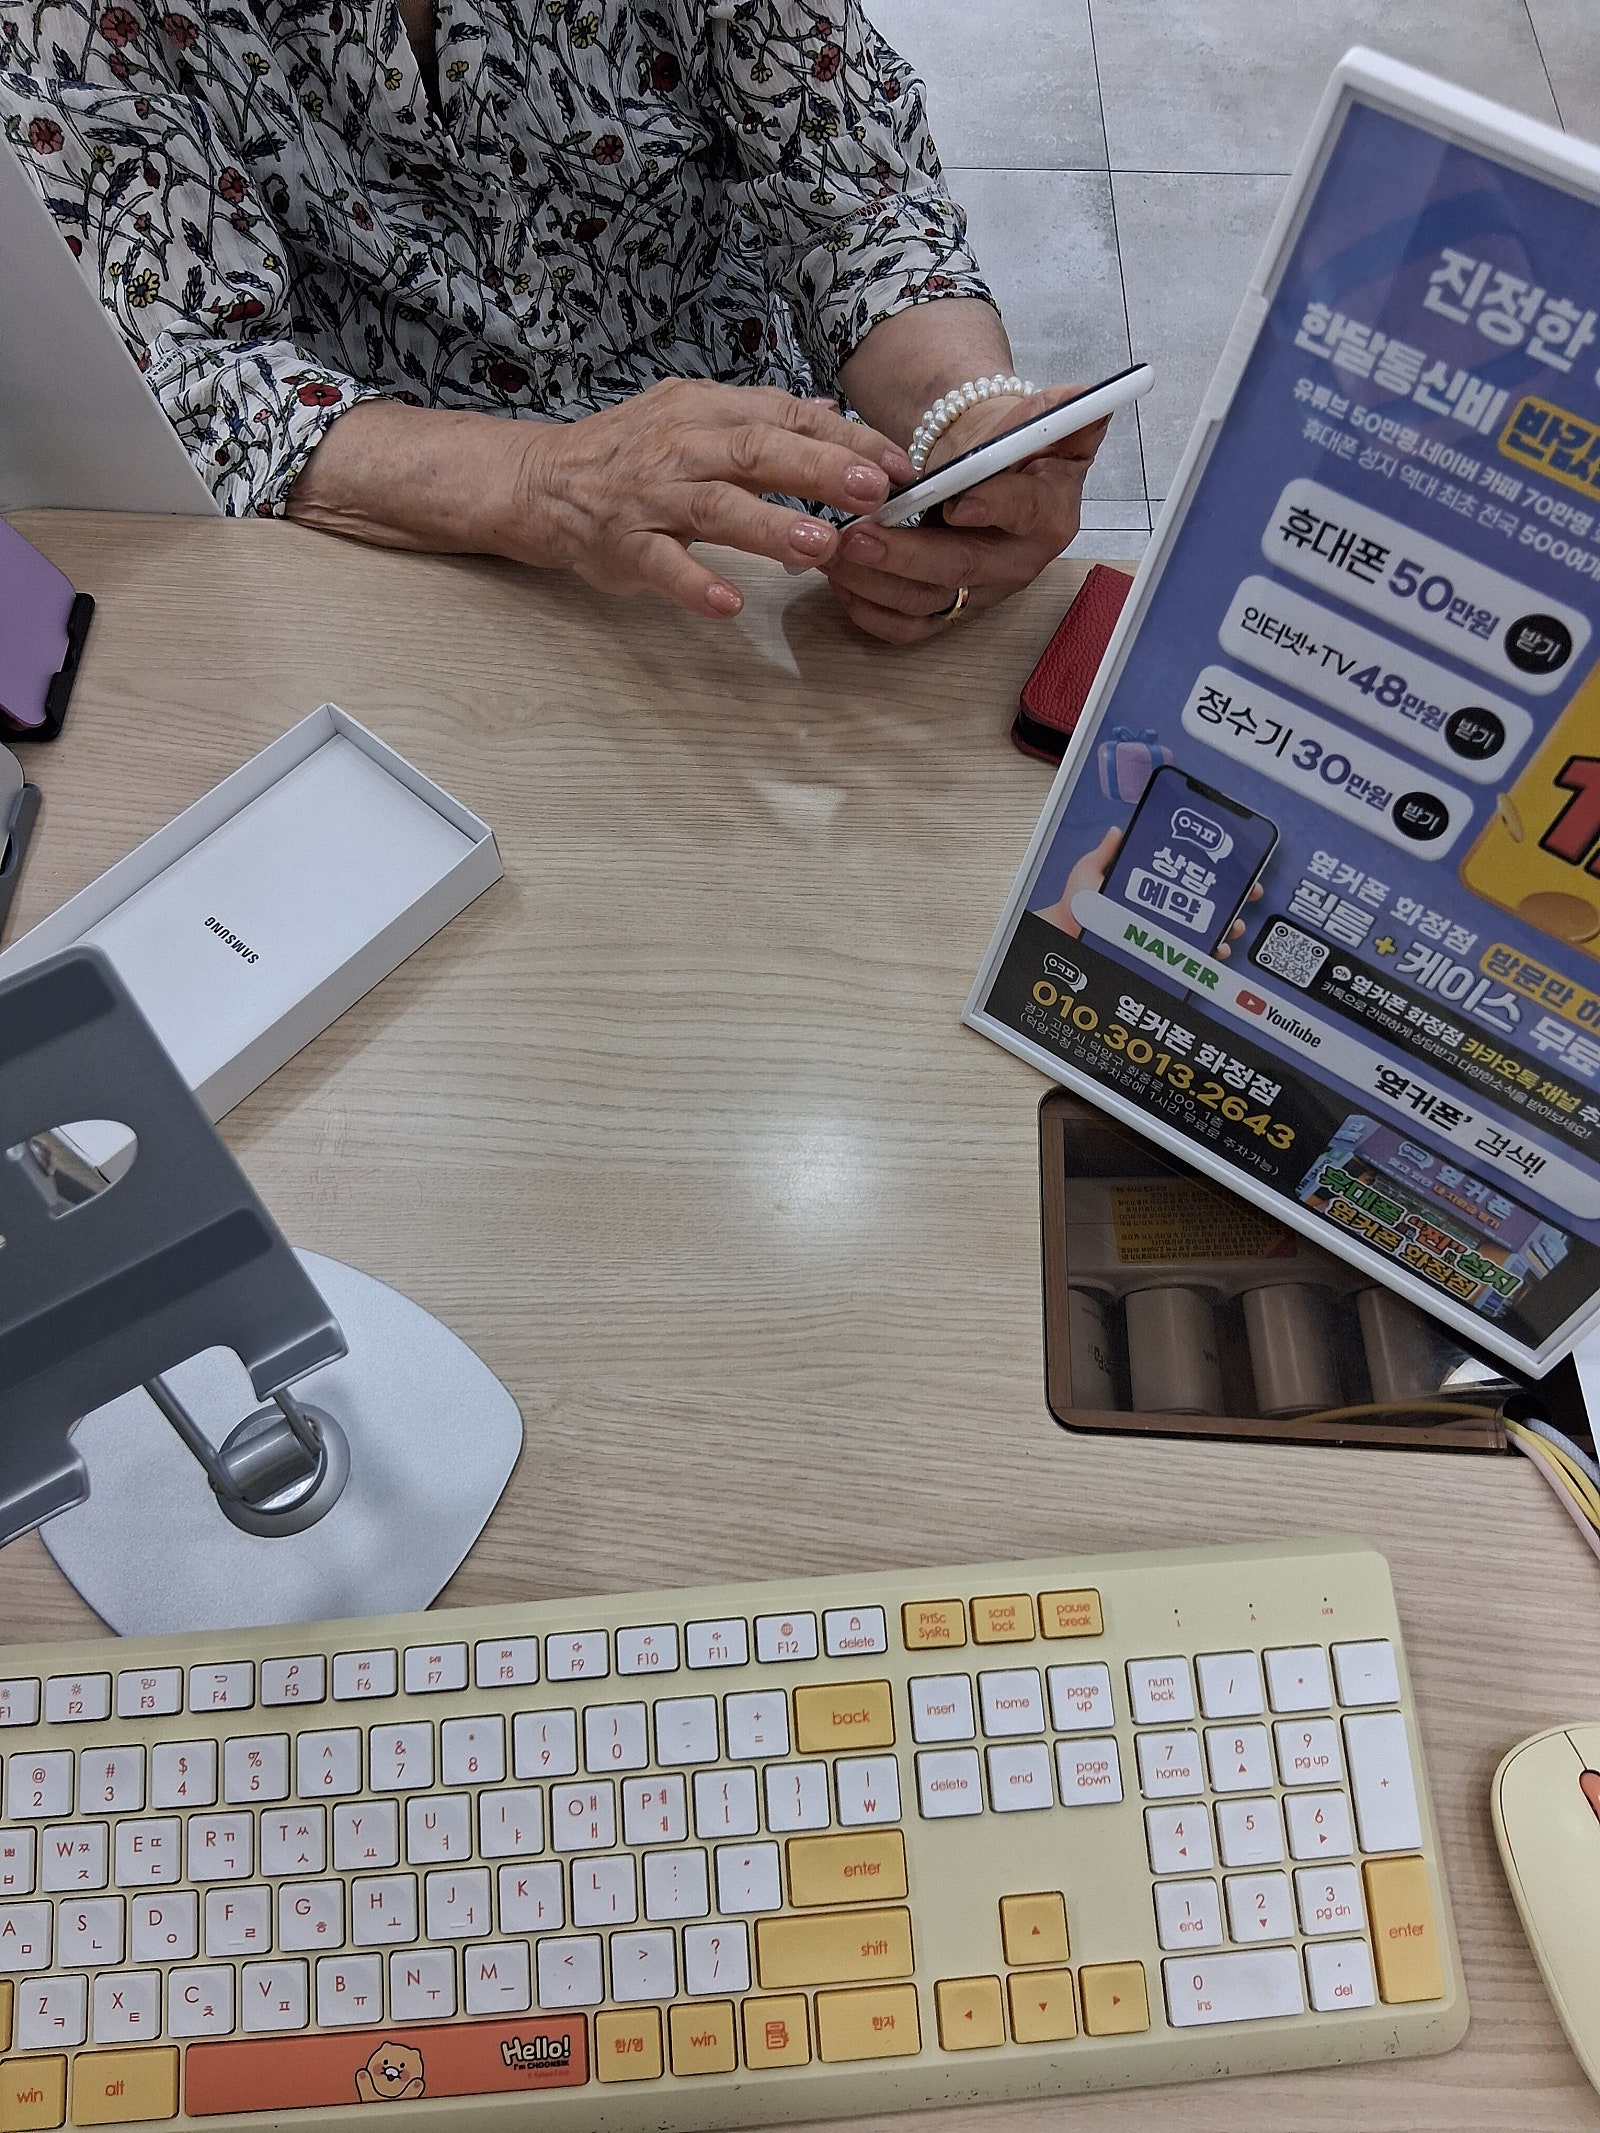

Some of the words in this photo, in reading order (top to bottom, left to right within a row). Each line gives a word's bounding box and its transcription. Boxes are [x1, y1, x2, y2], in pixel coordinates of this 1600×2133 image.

[1422, 247, 1597, 373] 진정한
[1294, 302, 1510, 435] 한달통신비
[1293, 377, 1350, 420] 유튜브
[1478, 466, 1523, 502] 카페
[1522, 487, 1594, 538] 70만명
[1302, 417, 1359, 461] 휴대폰
[1358, 447, 1399, 479] 성지
[1400, 463, 1439, 498] 역대
[1439, 482, 1479, 518] 최초
[1478, 503, 1520, 538] 전국
[1279, 505, 1391, 585] 휴대폰
[1388, 558, 1500, 641] 50만원
[1517, 626, 1563, 663] 받기
[1455, 718, 1497, 750] 받기
[1196, 685, 1294, 758] 정수기
[1291, 739, 1395, 812] 30만원
[1401, 801, 1441, 832] 받기
[1153, 846, 1217, 897] 상담
[1137, 876, 1203, 924] 예약
[1307, 850, 1390, 908] 옆커폰
[1390, 896, 1479, 956] 화정점
[1488, 950, 1576, 1009] 방문만
[204, 915, 259, 965] SAMSUNG
[1123, 923, 1220, 991] NAVER
[1287, 878, 1375, 949] 필름
[1374, 936, 1397, 956] +
[1396, 941, 1522, 1034] 케이스
[1025, 1001, 1047, 1022] 경기
[1049, 1014, 1086, 1046] 고양시
[1089, 1037, 1125, 1067] 덕양구
[1265, 1006, 1322, 1049] YouTube
[1115, 994, 1195, 1056] 옆커폰
[1194, 1042, 1282, 1107] 화정점
[1350, 973, 1406, 1015] 옆커폰
[1403, 1004, 1465, 1051] 화정점
[1461, 1036, 1540, 1090] 카카오톡
[1540, 1081, 1581, 1114] 채널
[1032, 980, 1296, 1150] 010.3013.2643
[1150, 1091, 1181, 1115] 1시간
[1182, 1112, 1222, 1140] 무료로
[1223, 1137, 1280, 1176] 주차가능)
[1474, 1127, 1548, 1179] 검색!
[1320, 1167, 1402, 1226] 휴대폰
[1457, 1253, 1522, 1297] 성지
[1329, 1200, 1402, 1252] 옆커폰
[1401, 1245, 1478, 1299] 화정점
[988, 1607, 1016, 1620] scroll
[1055, 1601, 1091, 1614] pause
[918, 1611, 948, 1628] PrtSc
[990, 1616, 1016, 1632] lock
[1057, 1611, 1092, 1627] break
[919, 1625, 950, 1640] SysRq
[775, 1640, 799, 1654] F12
[839, 1637, 875, 1649] delete
[636, 1652, 660, 1665] F10
[707, 1646, 730, 1661] F11
[498, 1666, 514, 1679] F8
[570, 1659, 585, 1672] F9
[427, 1670, 442, 1682] F7
[1147, 1676, 1174, 1688] num
[283, 1683, 300, 1696] F5
[355, 1678, 371, 1691] F6
[1067, 1686, 1100, 1698] page
[139, 1695, 156, 1710] F3
[211, 1691, 227, 1702] F4
[1149, 1689, 1175, 1702] lock
[67, 1699, 84, 1715] F2
[925, 1702, 957, 1715] insert
[995, 1698, 1030, 1710] home
[1076, 1696, 1092, 1712] up
[0, 1706, 12, 1719] F1
[831, 1710, 870, 1727] back
[1234, 1739, 1244, 1755] 8
[1303, 1733, 1312, 1747] 9
[540, 1750, 551, 1766] 9
[611, 1744, 623, 1761] 0
[1166, 1745, 1175, 1761] 7
[396, 1762, 406, 1779] 7
[468, 1757, 478, 1774] 8
[1075, 1759, 1110, 1774] page
[1293, 1757, 1311, 1770] pg
[1313, 1755, 1329, 1767] up
[323, 1771, 333, 1785] 6
[1009, 1771, 1034, 1785] end
[1076, 1772, 1112, 1786] down
[1155, 1767, 1191, 1779] home
[178, 1782, 187, 1796] 4
[250, 1775, 260, 1792] 5
[930, 1779, 969, 1792] delete
[33, 1791, 43, 1808] 2
[105, 1786, 115, 1802] 3
[640, 1792, 652, 1809] P
[567, 1799, 584, 1818] O
[1315, 1809, 1324, 1823] 6
[352, 1819, 365, 1836] Y
[423, 1813, 436, 1829] U
[1246, 1814, 1255, 1828] 5
[278, 1824, 291, 1841] T
[1174, 1823, 1184, 1836] 4
[133, 1836, 143, 1853] E
[205, 1831, 216, 1846] R
[57, 1842, 73, 1857] W
[843, 1860, 883, 1878] enter
[1257, 1894, 1265, 1910] 2
[1327, 1886, 1336, 1902] 3
[224, 1903, 234, 1921] F
[1184, 1901, 1191, 1916] 1
[1315, 1909, 1333, 1920] pg
[1330, 1905, 1350, 1919] dn
[77, 1914, 87, 1932] S
[147, 1909, 163, 1927] D
[1178, 1919, 1204, 1933] end
[3, 1920, 15, 1936] A
[1388, 1922, 1424, 1940] enter
[860, 1940, 889, 1957] shift
[1192, 1975, 1204, 1991] 0
[1335, 1985, 1353, 1997] del
[1196, 2001, 1212, 2012] ins
[871, 2015, 896, 2032] 한자
[614, 2037, 644, 2054] 한/영
[689, 2031, 717, 2048] win
[501, 2035, 570, 2066] Hello!
[16, 2087, 44, 2104] win
[105, 2080, 125, 2097] alt
